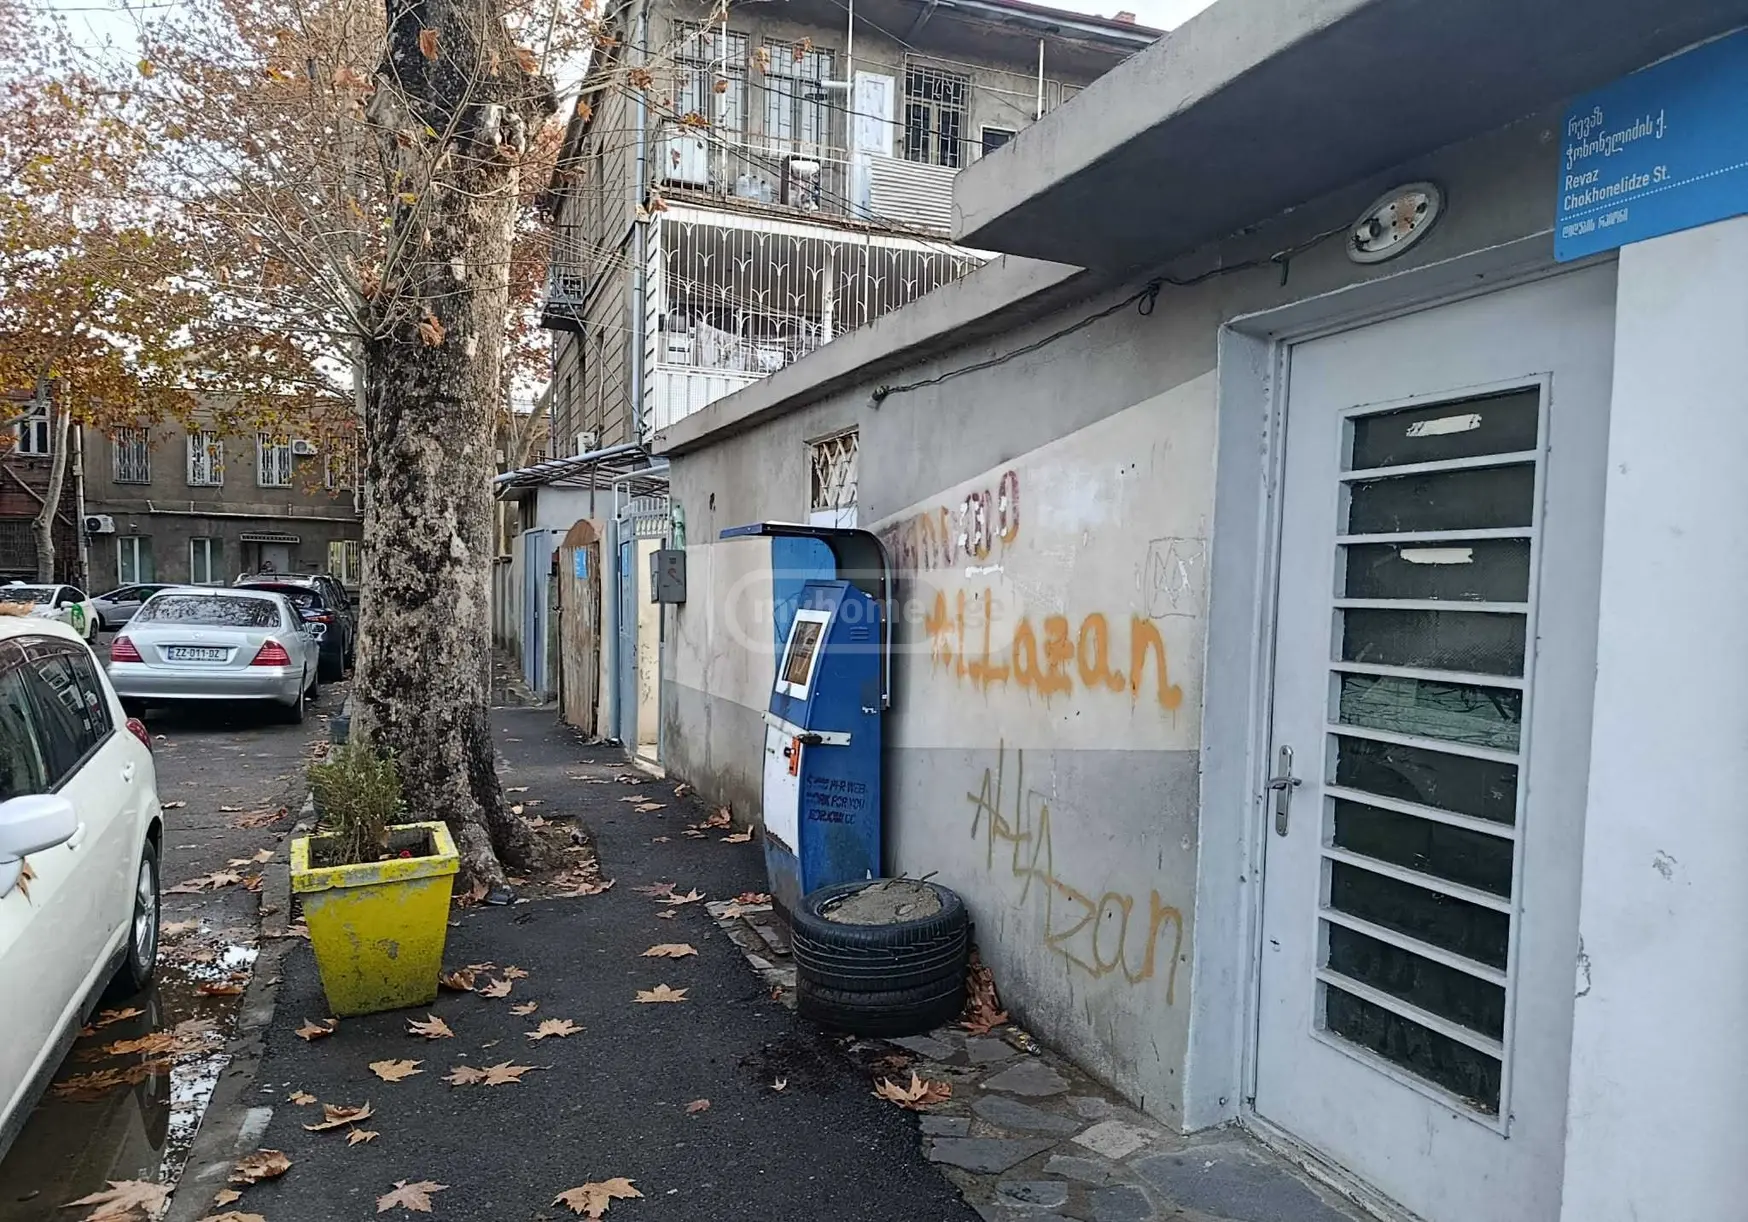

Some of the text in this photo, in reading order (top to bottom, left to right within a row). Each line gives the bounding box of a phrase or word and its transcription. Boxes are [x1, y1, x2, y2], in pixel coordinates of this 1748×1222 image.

[1566, 108, 1667, 170] ჭოხონელიძის ქ.
[1568, 106, 1603, 139] რევაზ
[1563, 165, 1671, 211] Chokhonelidze St.
[1565, 169, 1599, 191] Revaz
